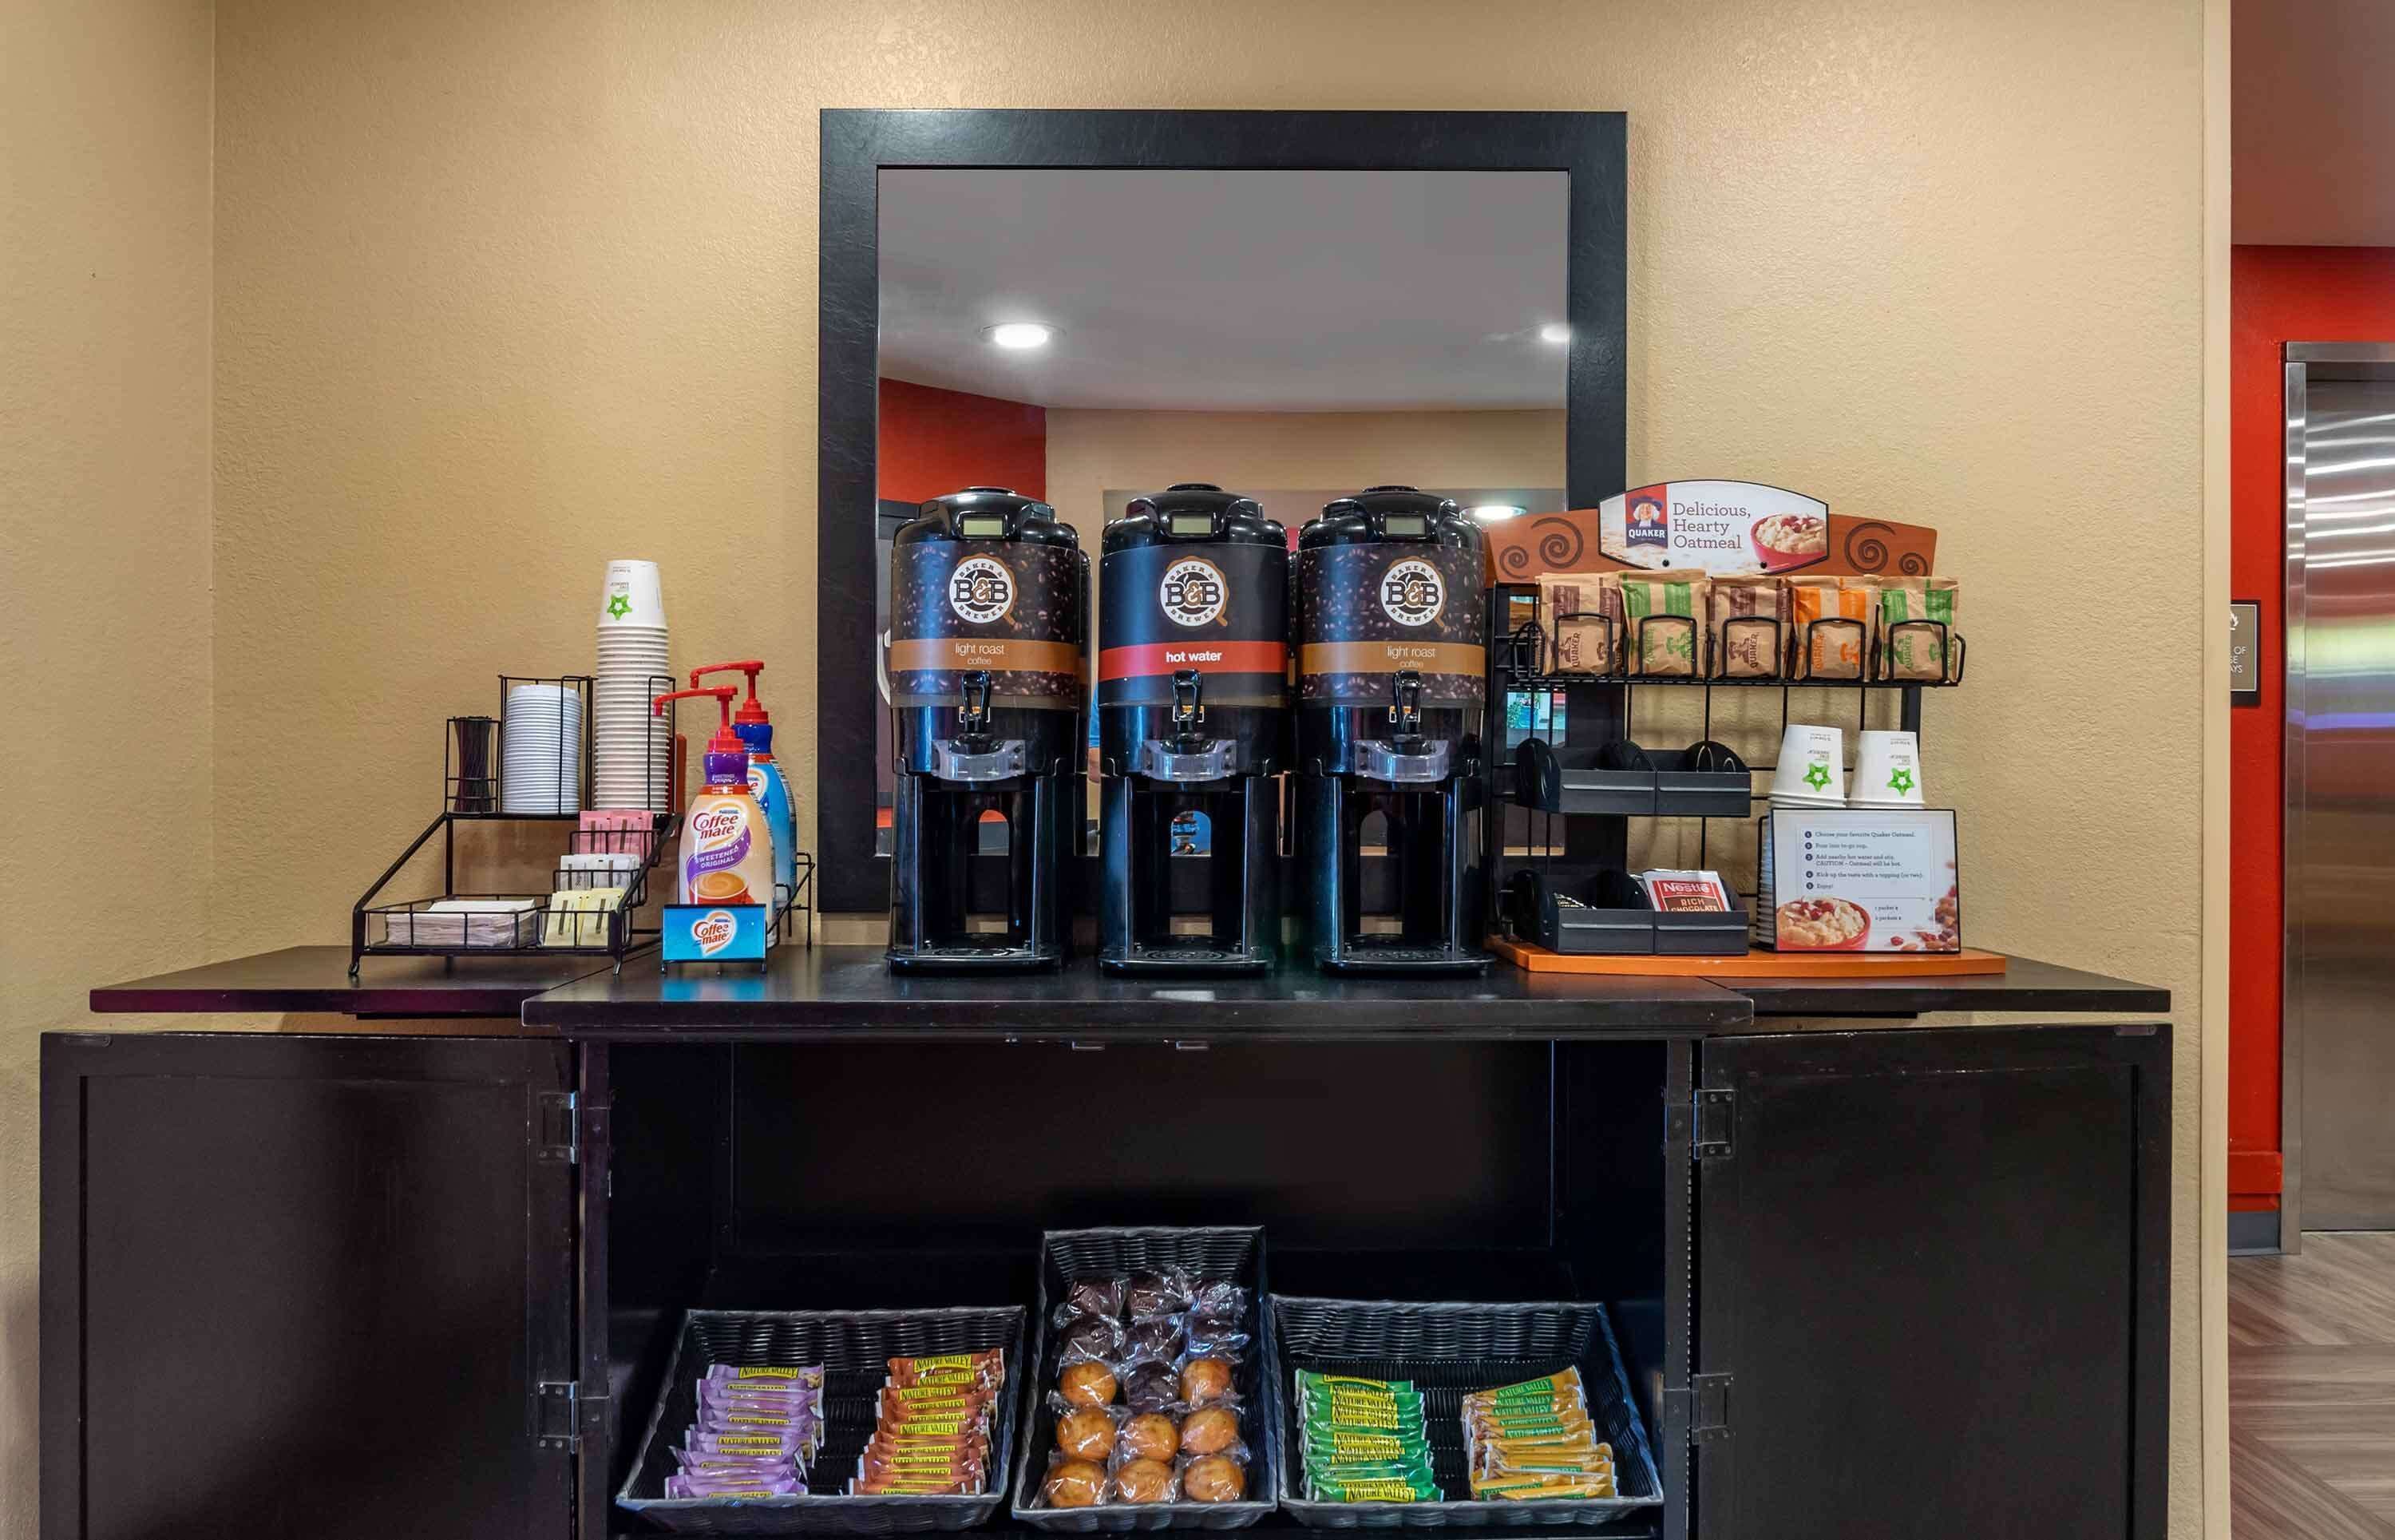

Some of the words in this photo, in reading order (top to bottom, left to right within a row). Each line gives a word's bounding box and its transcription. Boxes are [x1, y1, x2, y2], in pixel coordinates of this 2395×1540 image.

[1673, 501, 1751, 517] Delicious,
[1629, 529, 1666, 539] QUAKER
[1673, 519, 1730, 536] Hearty
[1673, 535, 1742, 549] Oatmeal
[953, 578, 1009, 604] B&B
[1165, 581, 1221, 607] B&B
[1385, 581, 1440, 607] B&B
[956, 642, 976, 656] light
[979, 644, 1004, 655] roast
[1388, 645, 1408, 659] light
[1411, 647, 1436, 658] roast
[1571, 632, 1580, 667] QUAKER
[2235, 646, 2246, 655] OF
[967, 657, 992, 666] coffee
[1166, 651, 1186, 663] hot
[1188, 651, 1222, 662] water
[693, 812, 738, 831] Coffee
[700, 825, 734, 839] mate
[700, 856, 735, 869] ORIGINAL
[1680, 898, 1705, 907] RICH
[694, 921, 729, 938] Coffee
[703, 932, 727, 945] mate
[916, 1358, 943, 1371] NATURE
[944, 1355, 971, 1367] VALLEY
[920, 1376, 945, 1386] NATURE
[947, 1372, 972, 1383] VALLEY
[1498, 1385, 1524, 1397] NATURE
[1525, 1379, 1550, 1391] VALLEY
[1335, 1396, 1366, 1406] NATURE
[1367, 1399, 1395, 1411] VALLEY
[1334, 1406, 1367, 1417] NATURE
[1367, 1408, 1396, 1421] VALLEY
[902, 1424, 930, 1435] NATURE
[931, 1423, 956, 1435] VALLEY
[1349, 1487, 1383, 1501] NATURE
[1383, 1487, 1413, 1500] VALLEY
